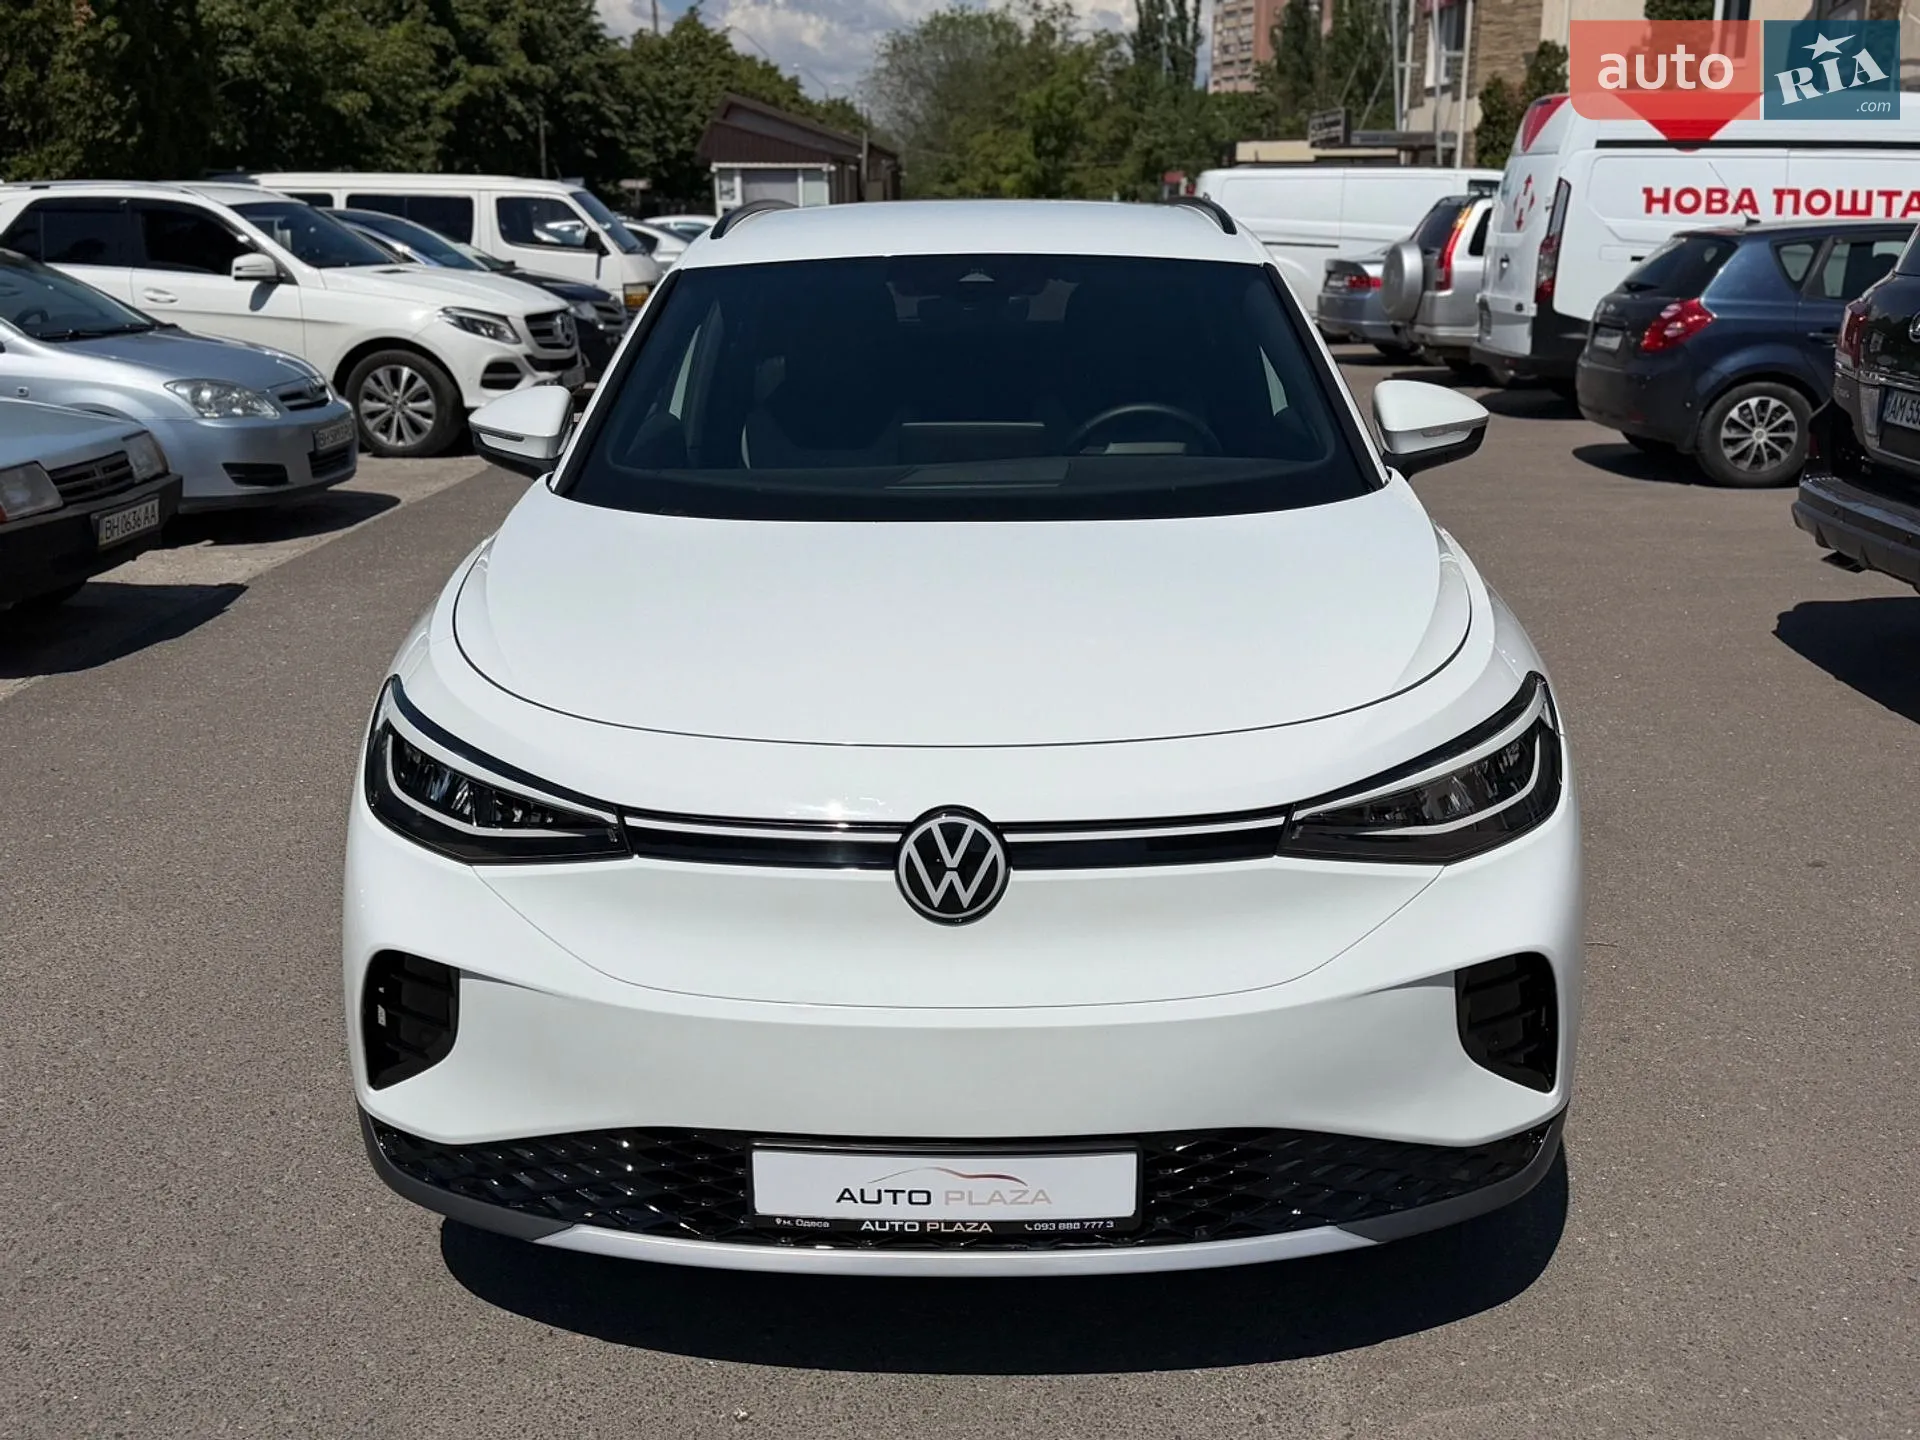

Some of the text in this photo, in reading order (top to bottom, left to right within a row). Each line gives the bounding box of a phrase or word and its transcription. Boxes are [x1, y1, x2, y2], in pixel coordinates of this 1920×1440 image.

[1642, 187, 1920, 218] НОВА ПОШТА
[836, 1187, 1052, 1206] AUTO PLAZA
[860, 1221, 993, 1233] AUTO PLAZA
[1034, 1222, 1056, 1231] 093
